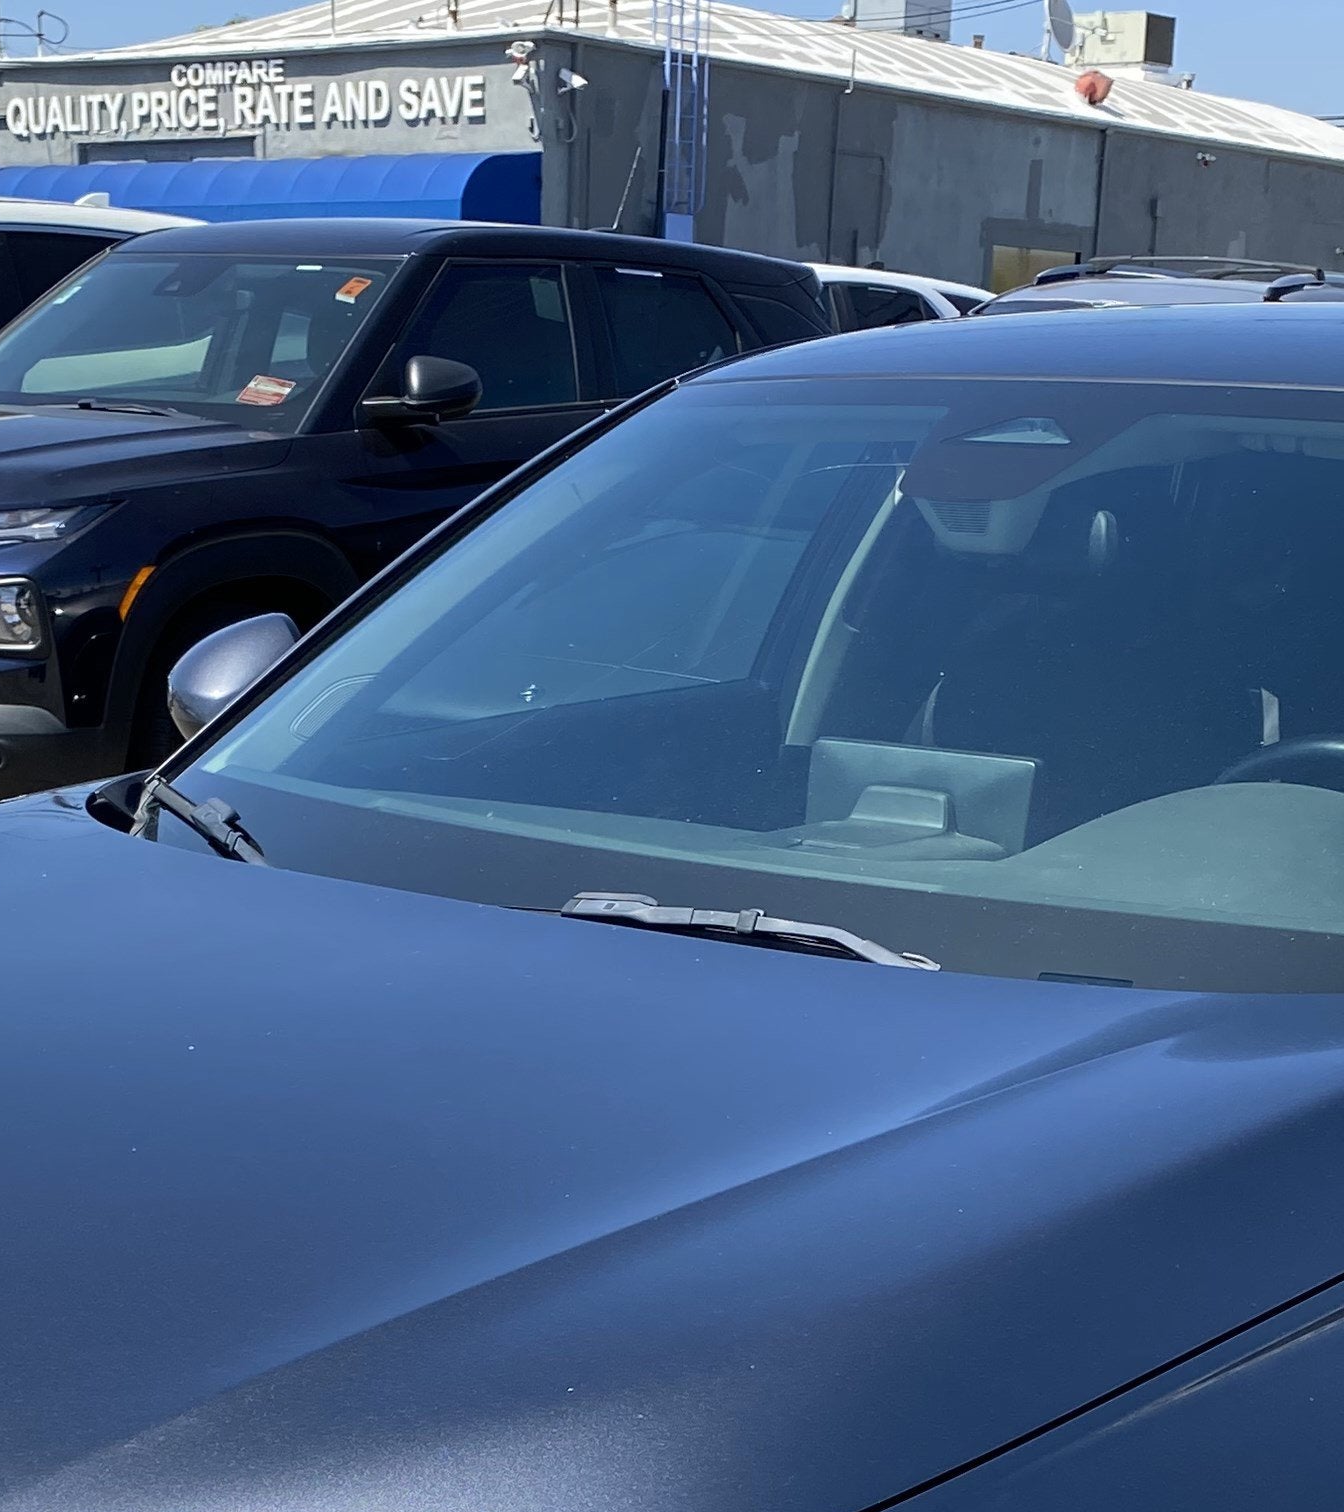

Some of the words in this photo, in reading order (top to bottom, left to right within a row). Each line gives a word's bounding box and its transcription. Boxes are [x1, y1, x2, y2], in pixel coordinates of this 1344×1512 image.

[170, 60, 285, 87] COMPARE
[6, 92, 128, 138] QUALITY,
[131, 87, 226, 137] PRICE,
[233, 83, 314, 124] RATE
[321, 80, 390, 122] AND
[398, 75, 485, 120] SAVE
